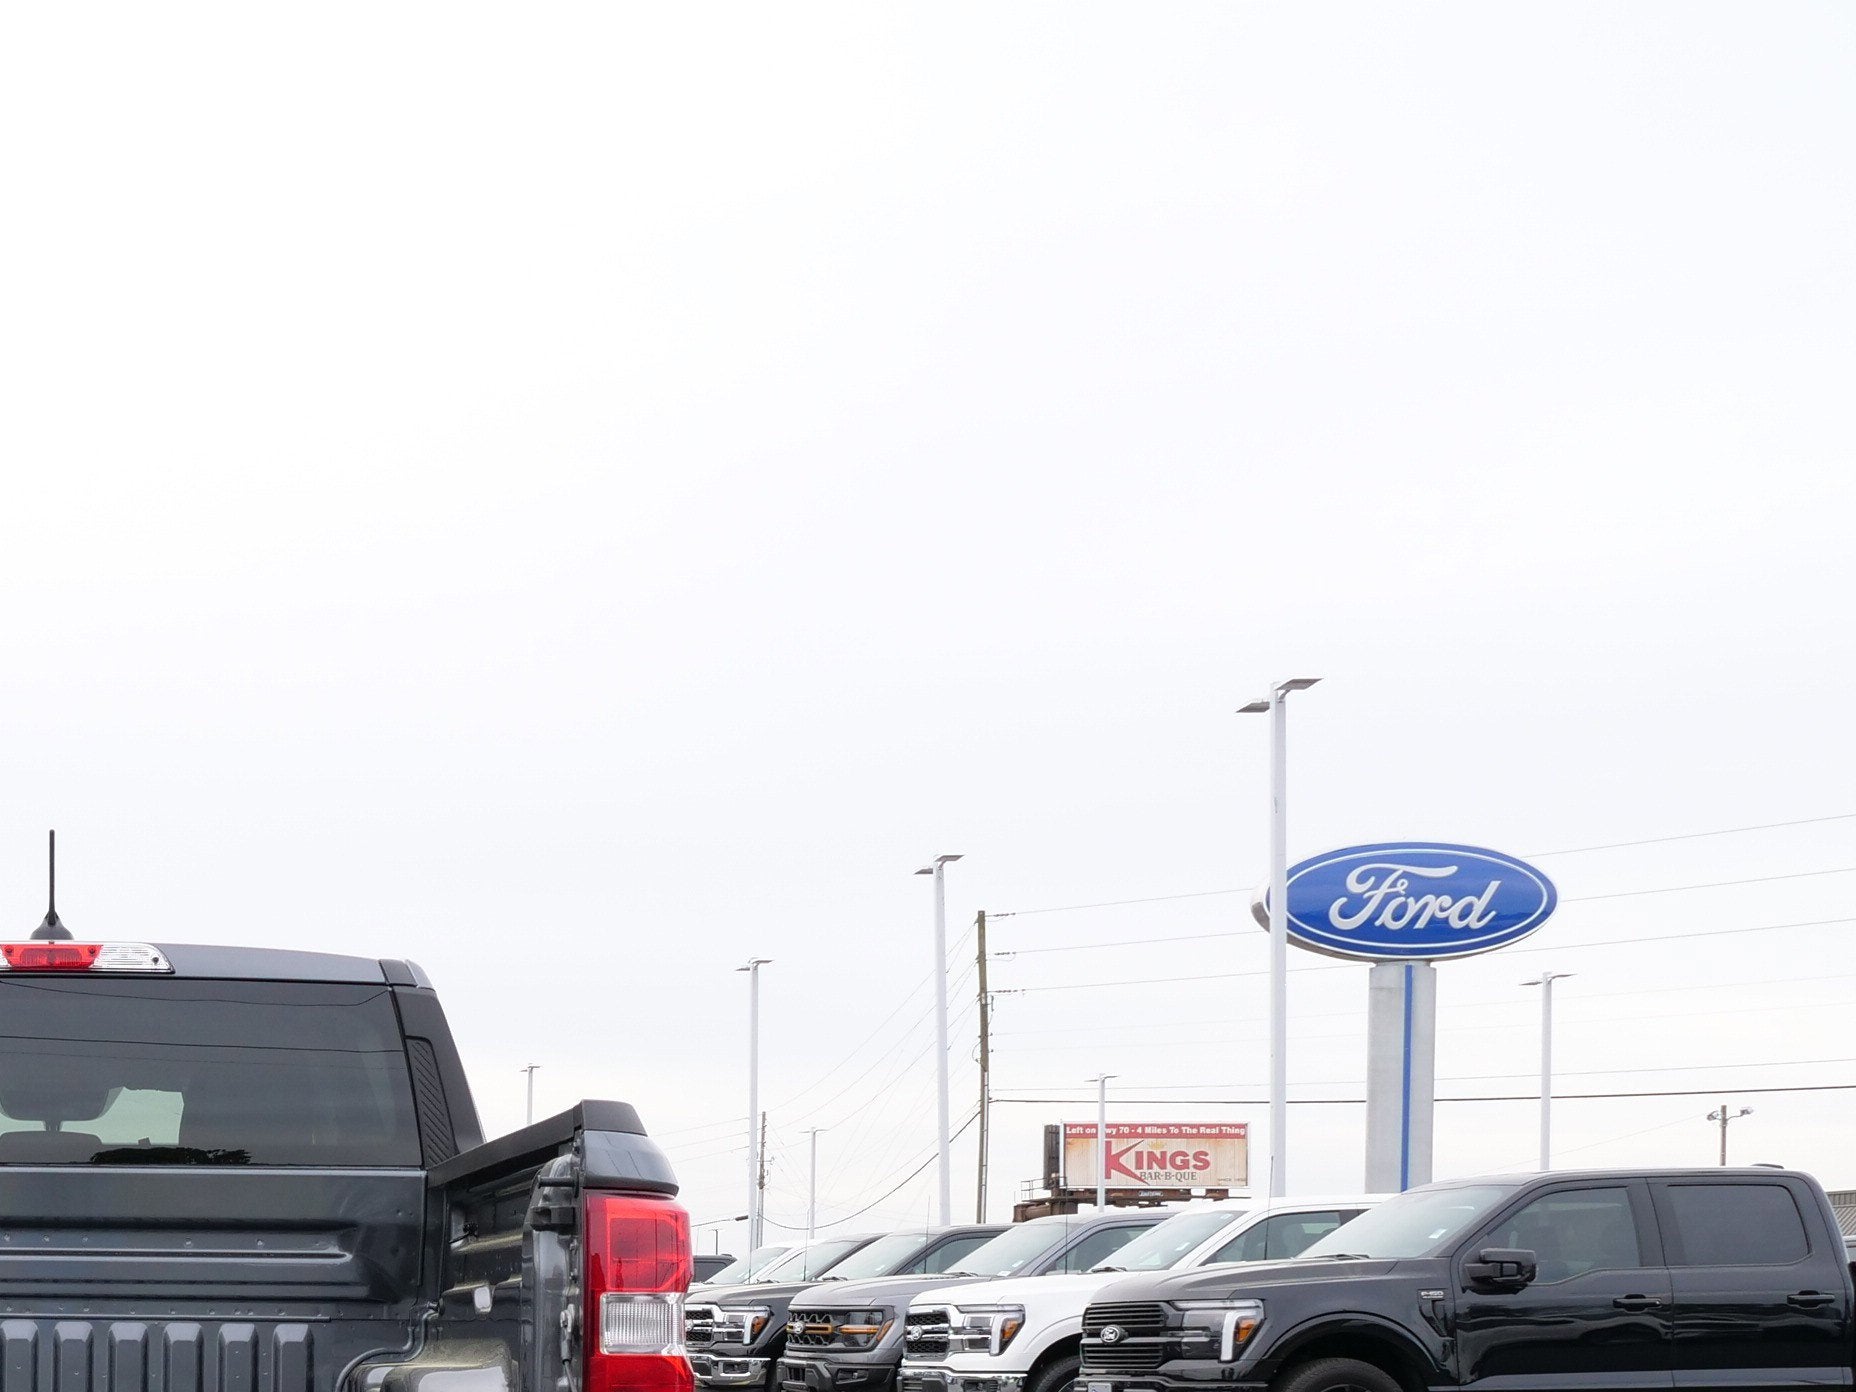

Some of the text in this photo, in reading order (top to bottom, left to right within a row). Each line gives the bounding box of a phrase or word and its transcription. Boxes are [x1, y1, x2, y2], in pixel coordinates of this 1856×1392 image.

[1328, 863, 1501, 930] Ford
[1066, 1126, 1084, 1134] Left
[1105, 1127, 1117, 1135] wy
[1119, 1126, 1129, 1134] 70
[1136, 1126, 1142, 1134] 4
[1144, 1126, 1167, 1134] Miles
[1169, 1126, 1179, 1134] To
[1181, 1126, 1198, 1134] The
[1199, 1126, 1219, 1134] Real
[1221, 1126, 1245, 1135] Thing
[1105, 1140, 1211, 1186] KINGS
[1140, 1172, 1197, 1181] BAR-B-QUE
